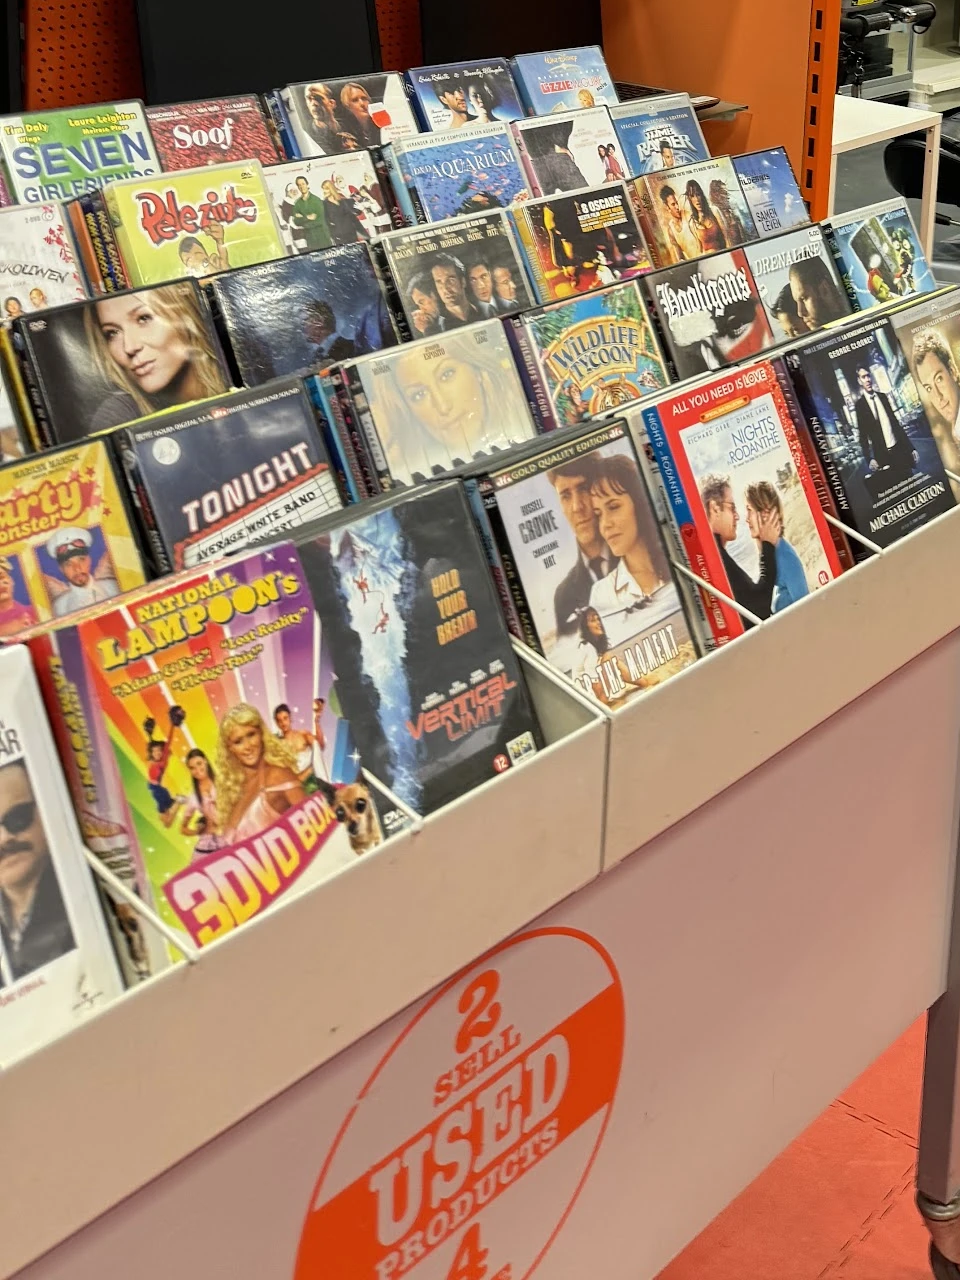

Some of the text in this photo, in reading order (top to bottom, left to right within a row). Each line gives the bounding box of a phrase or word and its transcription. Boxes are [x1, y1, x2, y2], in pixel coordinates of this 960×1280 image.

[540, 80, 573, 94] LIZZIE
[4, 122, 49, 135] Tim Daly
[68, 112, 137, 127] Laura Leighton
[173, 118, 233, 149] Soof
[12, 131, 152, 180] SEVEN
[18, 135, 41, 144] Wings
[431, 149, 515, 179] AQUARIUM
[580, 203, 588, 214] 8
[756, 206, 779, 223] SAMEN
[762, 218, 782, 232] LEVEN
[656, 269, 753, 320] Hooligans
[519, 337, 536, 382] WILDLIFE
[552, 323, 638, 369] WILDLIFE
[570, 345, 633, 382] TYCOON
[829, 335, 875, 360] GEORGE CLOONEY
[672, 401, 690, 417] ALL
[689, 393, 710, 409] YOU
[709, 382, 735, 400] NEED
[743, 369, 767, 389] LOVE
[686, 428, 714, 445] RICHARD
[715, 422, 731, 434] GERE
[735, 413, 754, 425] DIANE
[754, 404, 770, 416] LANE
[731, 415, 776, 448] NIGHTS
[511, 463, 538, 481] GOLD
[537, 448, 575, 469] QUALITY
[575, 433, 610, 453] EDITION
[646, 411, 683, 505] NIGHTS RODANTHE
[728, 431, 780, 464] RODANTHE
[0, 481, 83, 526] arty
[181, 441, 316, 534] TONIGHT
[906, 482, 946, 513] CLAYTON
[196, 490, 316, 561] AVERAGE WHITE BAND
[520, 498, 544, 517] RUSSELL
[0, 513, 59, 542] onster
[250, 520, 296, 545] ONCERT
[518, 509, 559, 544] CROWE
[136, 572, 238, 623] NATIONAL
[430, 568, 461, 598] HOLD
[436, 589, 469, 620] YOUR
[435, 609, 479, 646] BREATH
[597, 623, 680, 698] THE MOMENT
[496, 756, 508, 770] 12
[286, 793, 337, 852] BOX
[456, 969, 502, 1054] 2
[432, 1023, 522, 1108] SELL
[368, 1033, 571, 1247] USED
[373, 1116, 559, 1279] PRODUCTS
[446, 1222, 489, 1280] 4
